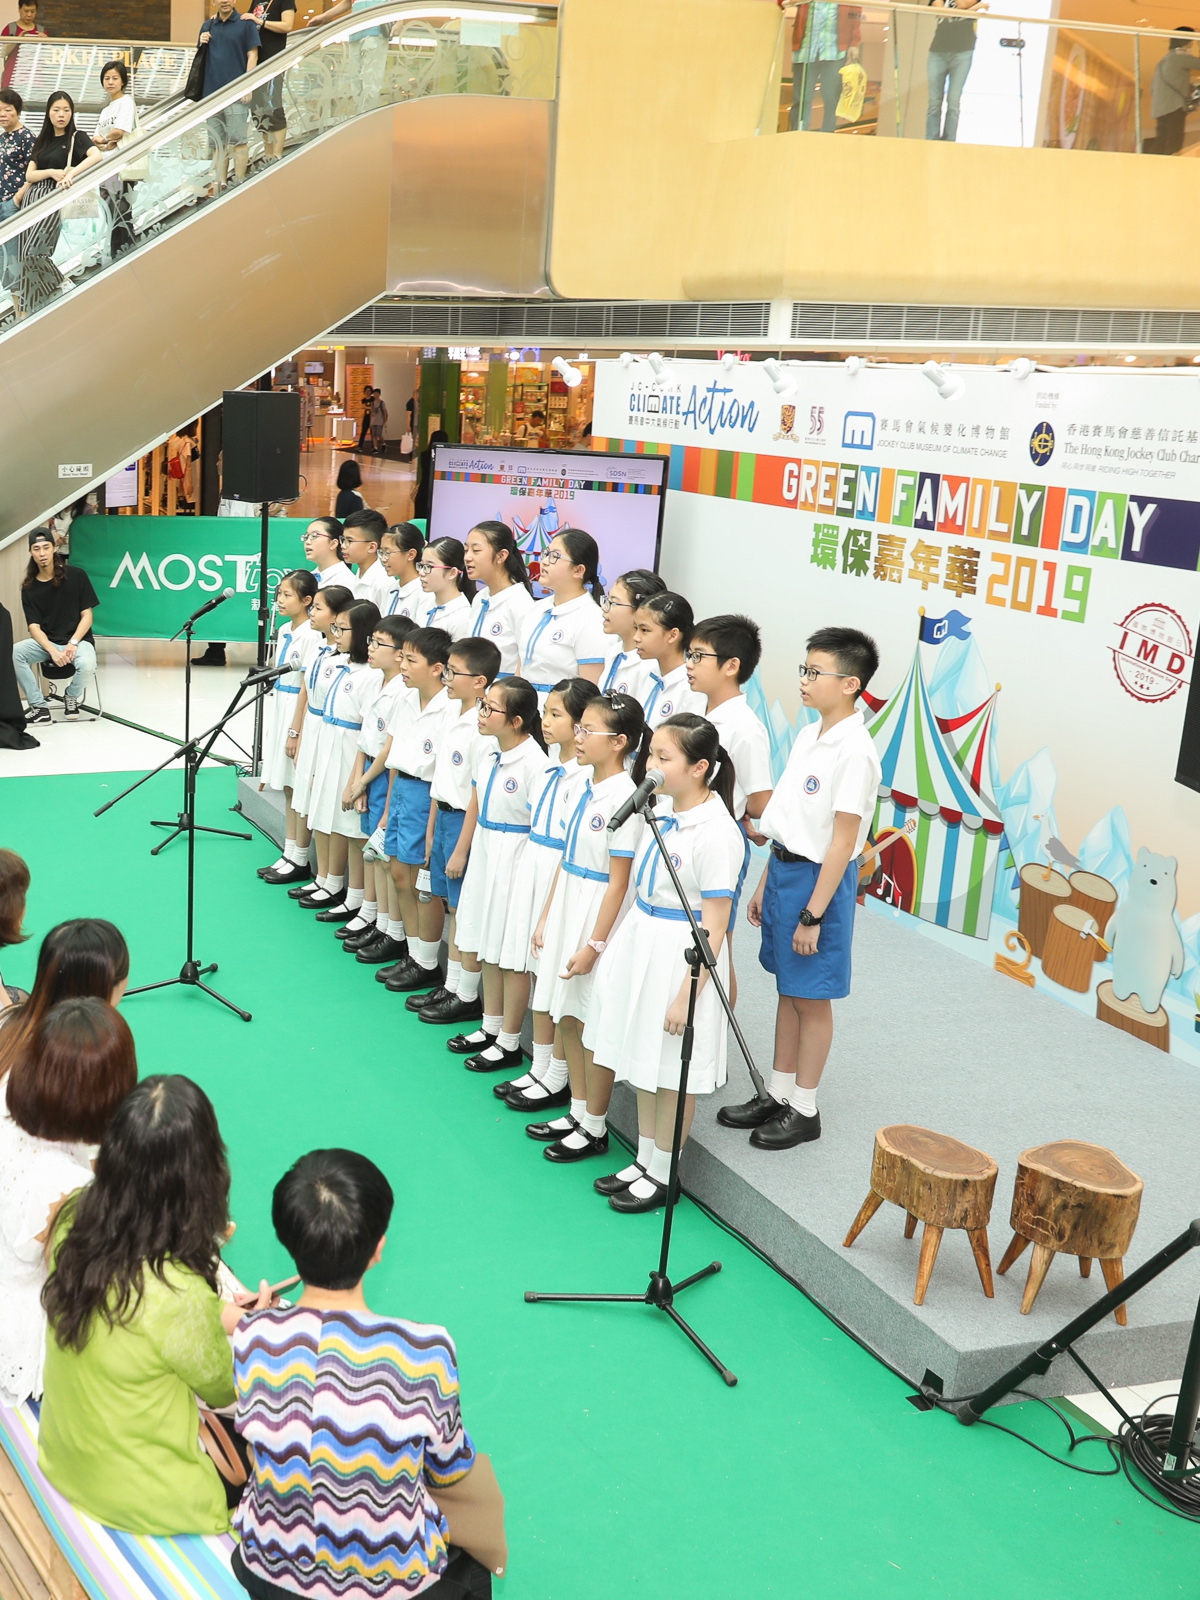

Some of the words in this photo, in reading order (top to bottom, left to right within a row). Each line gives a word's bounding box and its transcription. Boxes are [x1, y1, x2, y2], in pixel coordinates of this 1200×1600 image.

[682, 379, 760, 435] Action
[880, 418, 1011, 441] 賽馬會氣候變化博物館
[876, 439, 900, 450] JOCKEY
[900, 441, 915, 451] CLUB
[915, 442, 942, 453] MUSEUM
[943, 444, 951, 453] OF
[952, 445, 979, 456] CLIMATE
[980, 447, 1008, 459] CHANGE
[1064, 442, 1079, 454] The
[1080, 444, 1102, 459] Hong
[1103, 445, 1125, 461] Kong
[1126, 447, 1154, 463] Jockey
[1156, 448, 1177, 462] Club
[500, 475, 529, 486] GREEN
[530, 477, 565, 488] FAMILY
[568, 480, 586, 489] DAY
[1098, 465, 1121, 475] RIDING
[1122, 467, 1138, 476] HIGH
[1140, 469, 1176, 480] TOGETHER
[554, 489, 575, 500] 2019
[781, 461, 878, 514] GREEN
[892, 474, 1044, 536] FAMILY
[1062, 494, 1158, 554] DAY
[109, 551, 256, 593] MOST
[810, 522, 982, 599] 環保嘉年華
[985, 551, 1093, 624] 2019
